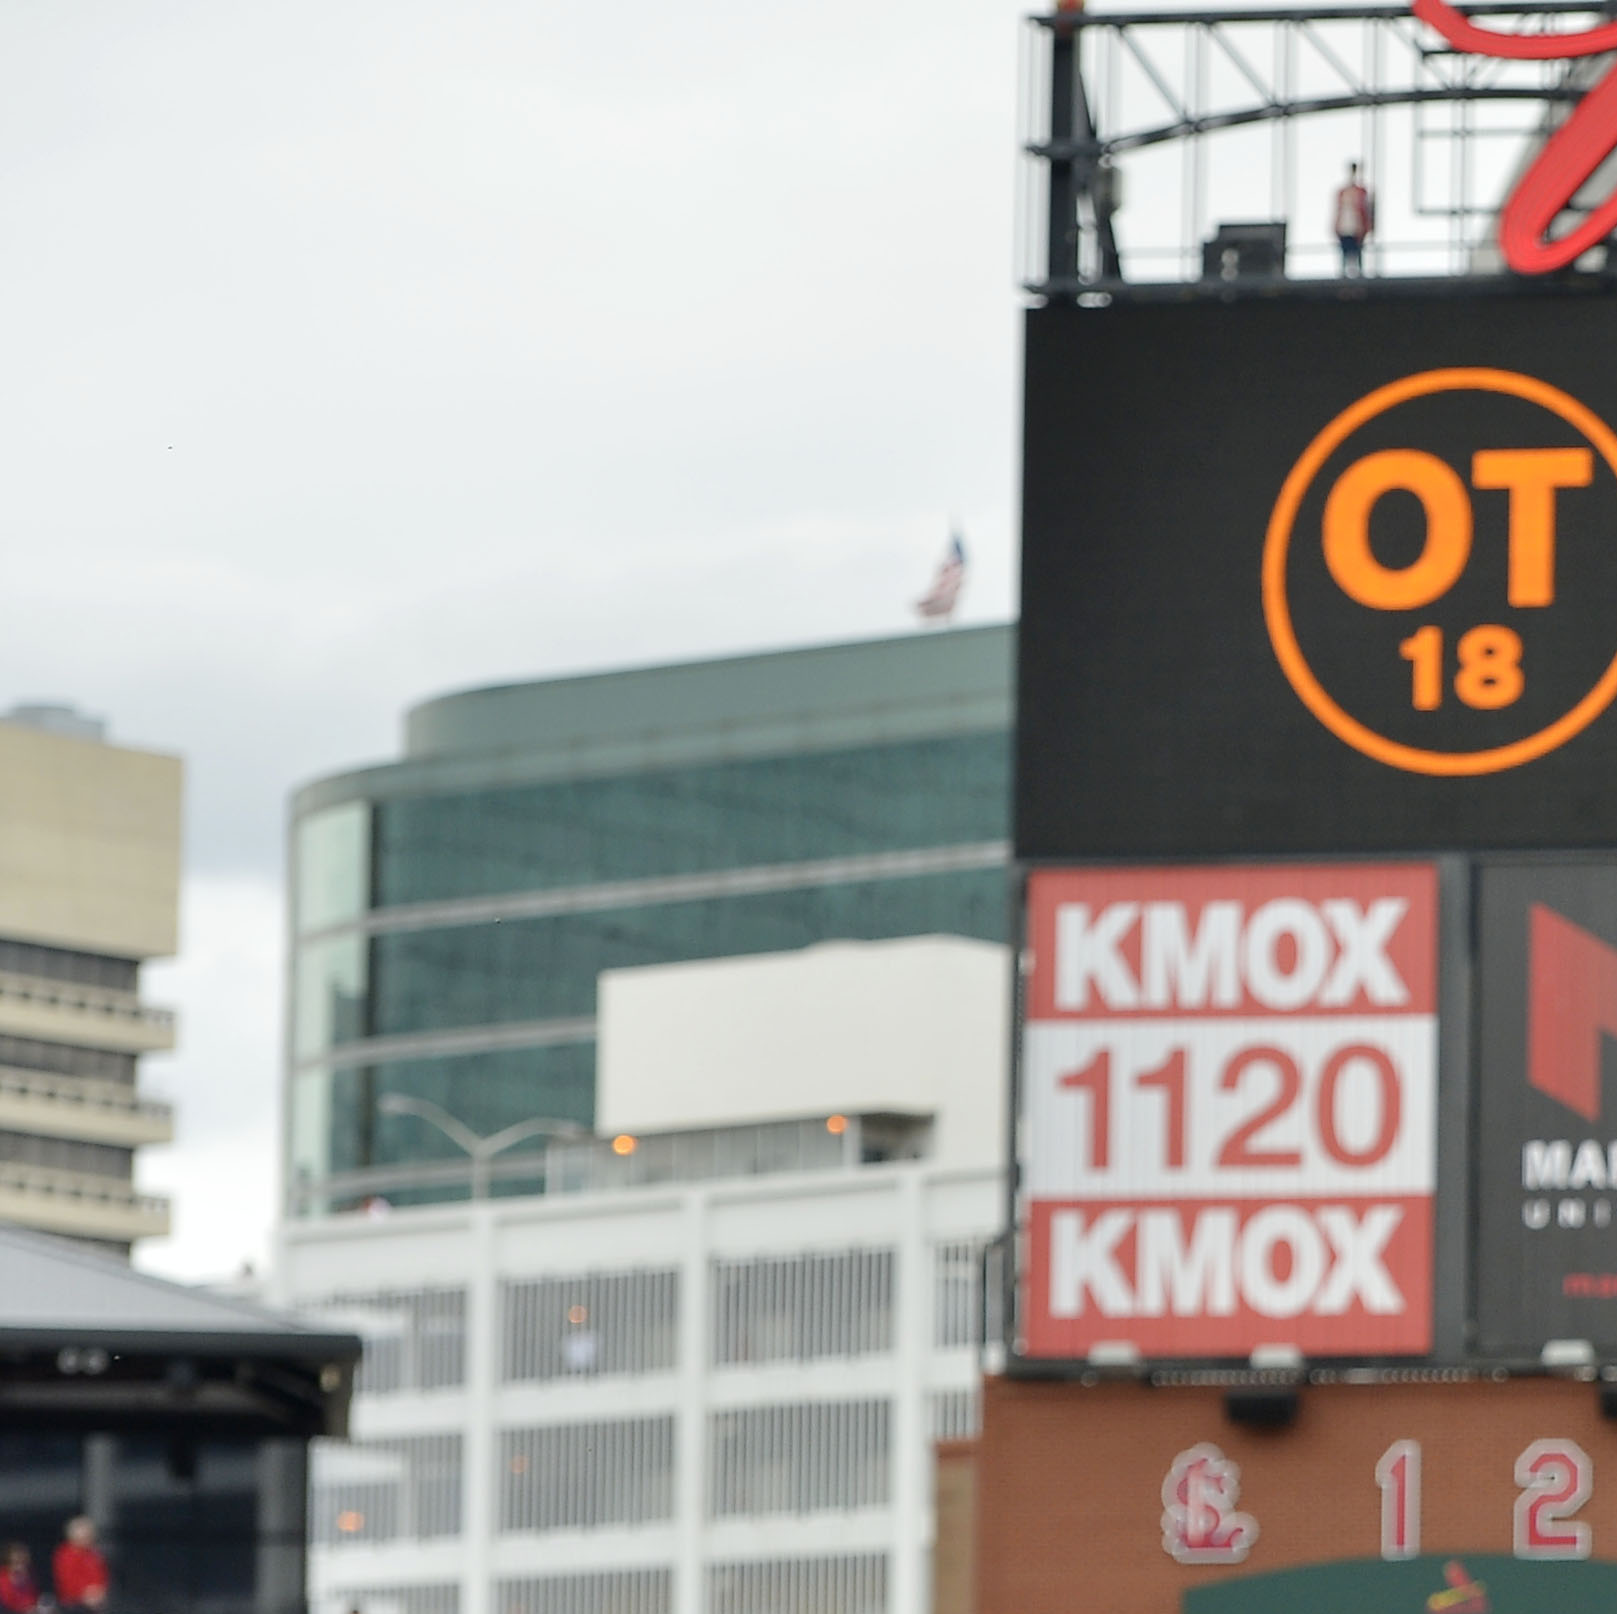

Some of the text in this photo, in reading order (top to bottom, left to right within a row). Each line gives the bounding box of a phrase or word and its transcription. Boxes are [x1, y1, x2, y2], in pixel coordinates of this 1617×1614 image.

[1320, 446, 1594, 612] OT
[1398, 625, 1524, 712] 18
[1053, 898, 1409, 1011] KMOX
[1058, 1043, 1405, 1175] 1120
[1048, 1205, 1405, 1319] KMOX
[1375, 1439, 1421, 1561] 1
[1514, 1438, 1592, 1561] 2
